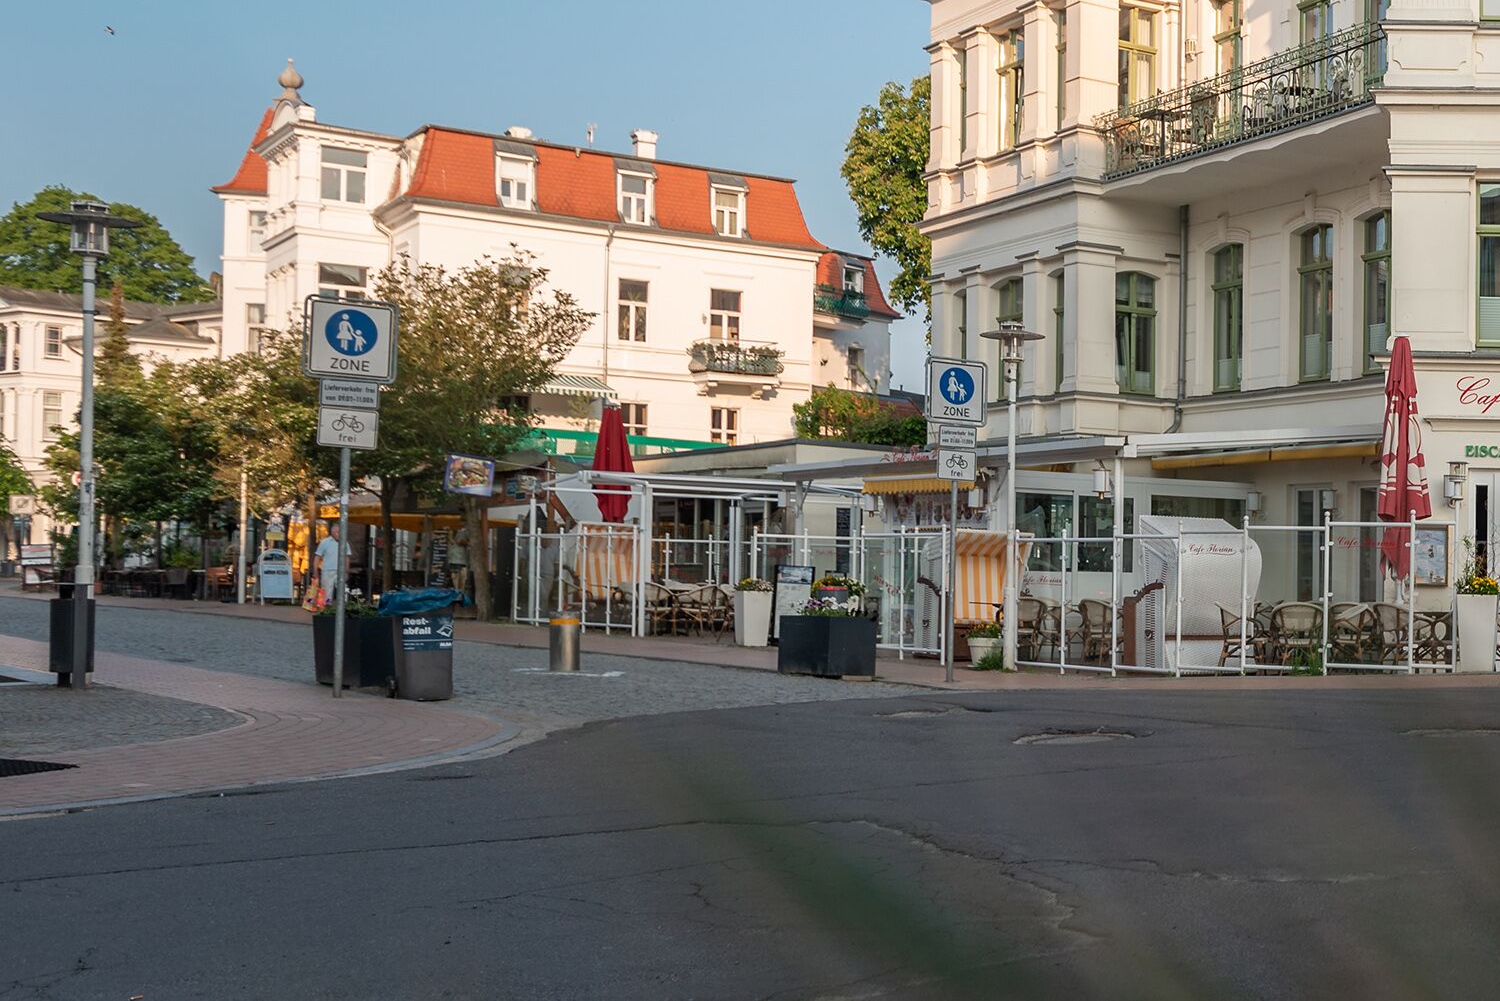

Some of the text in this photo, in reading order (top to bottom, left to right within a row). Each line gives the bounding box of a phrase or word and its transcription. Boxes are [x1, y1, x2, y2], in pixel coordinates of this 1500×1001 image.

[330, 357, 370, 372] ZONE
[943, 406, 970, 418] ZONE
[338, 433, 357, 443] frei
[950, 470, 963, 478] frei
[403, 617, 429, 625] Rest-
[403, 627, 431, 635] abfall
